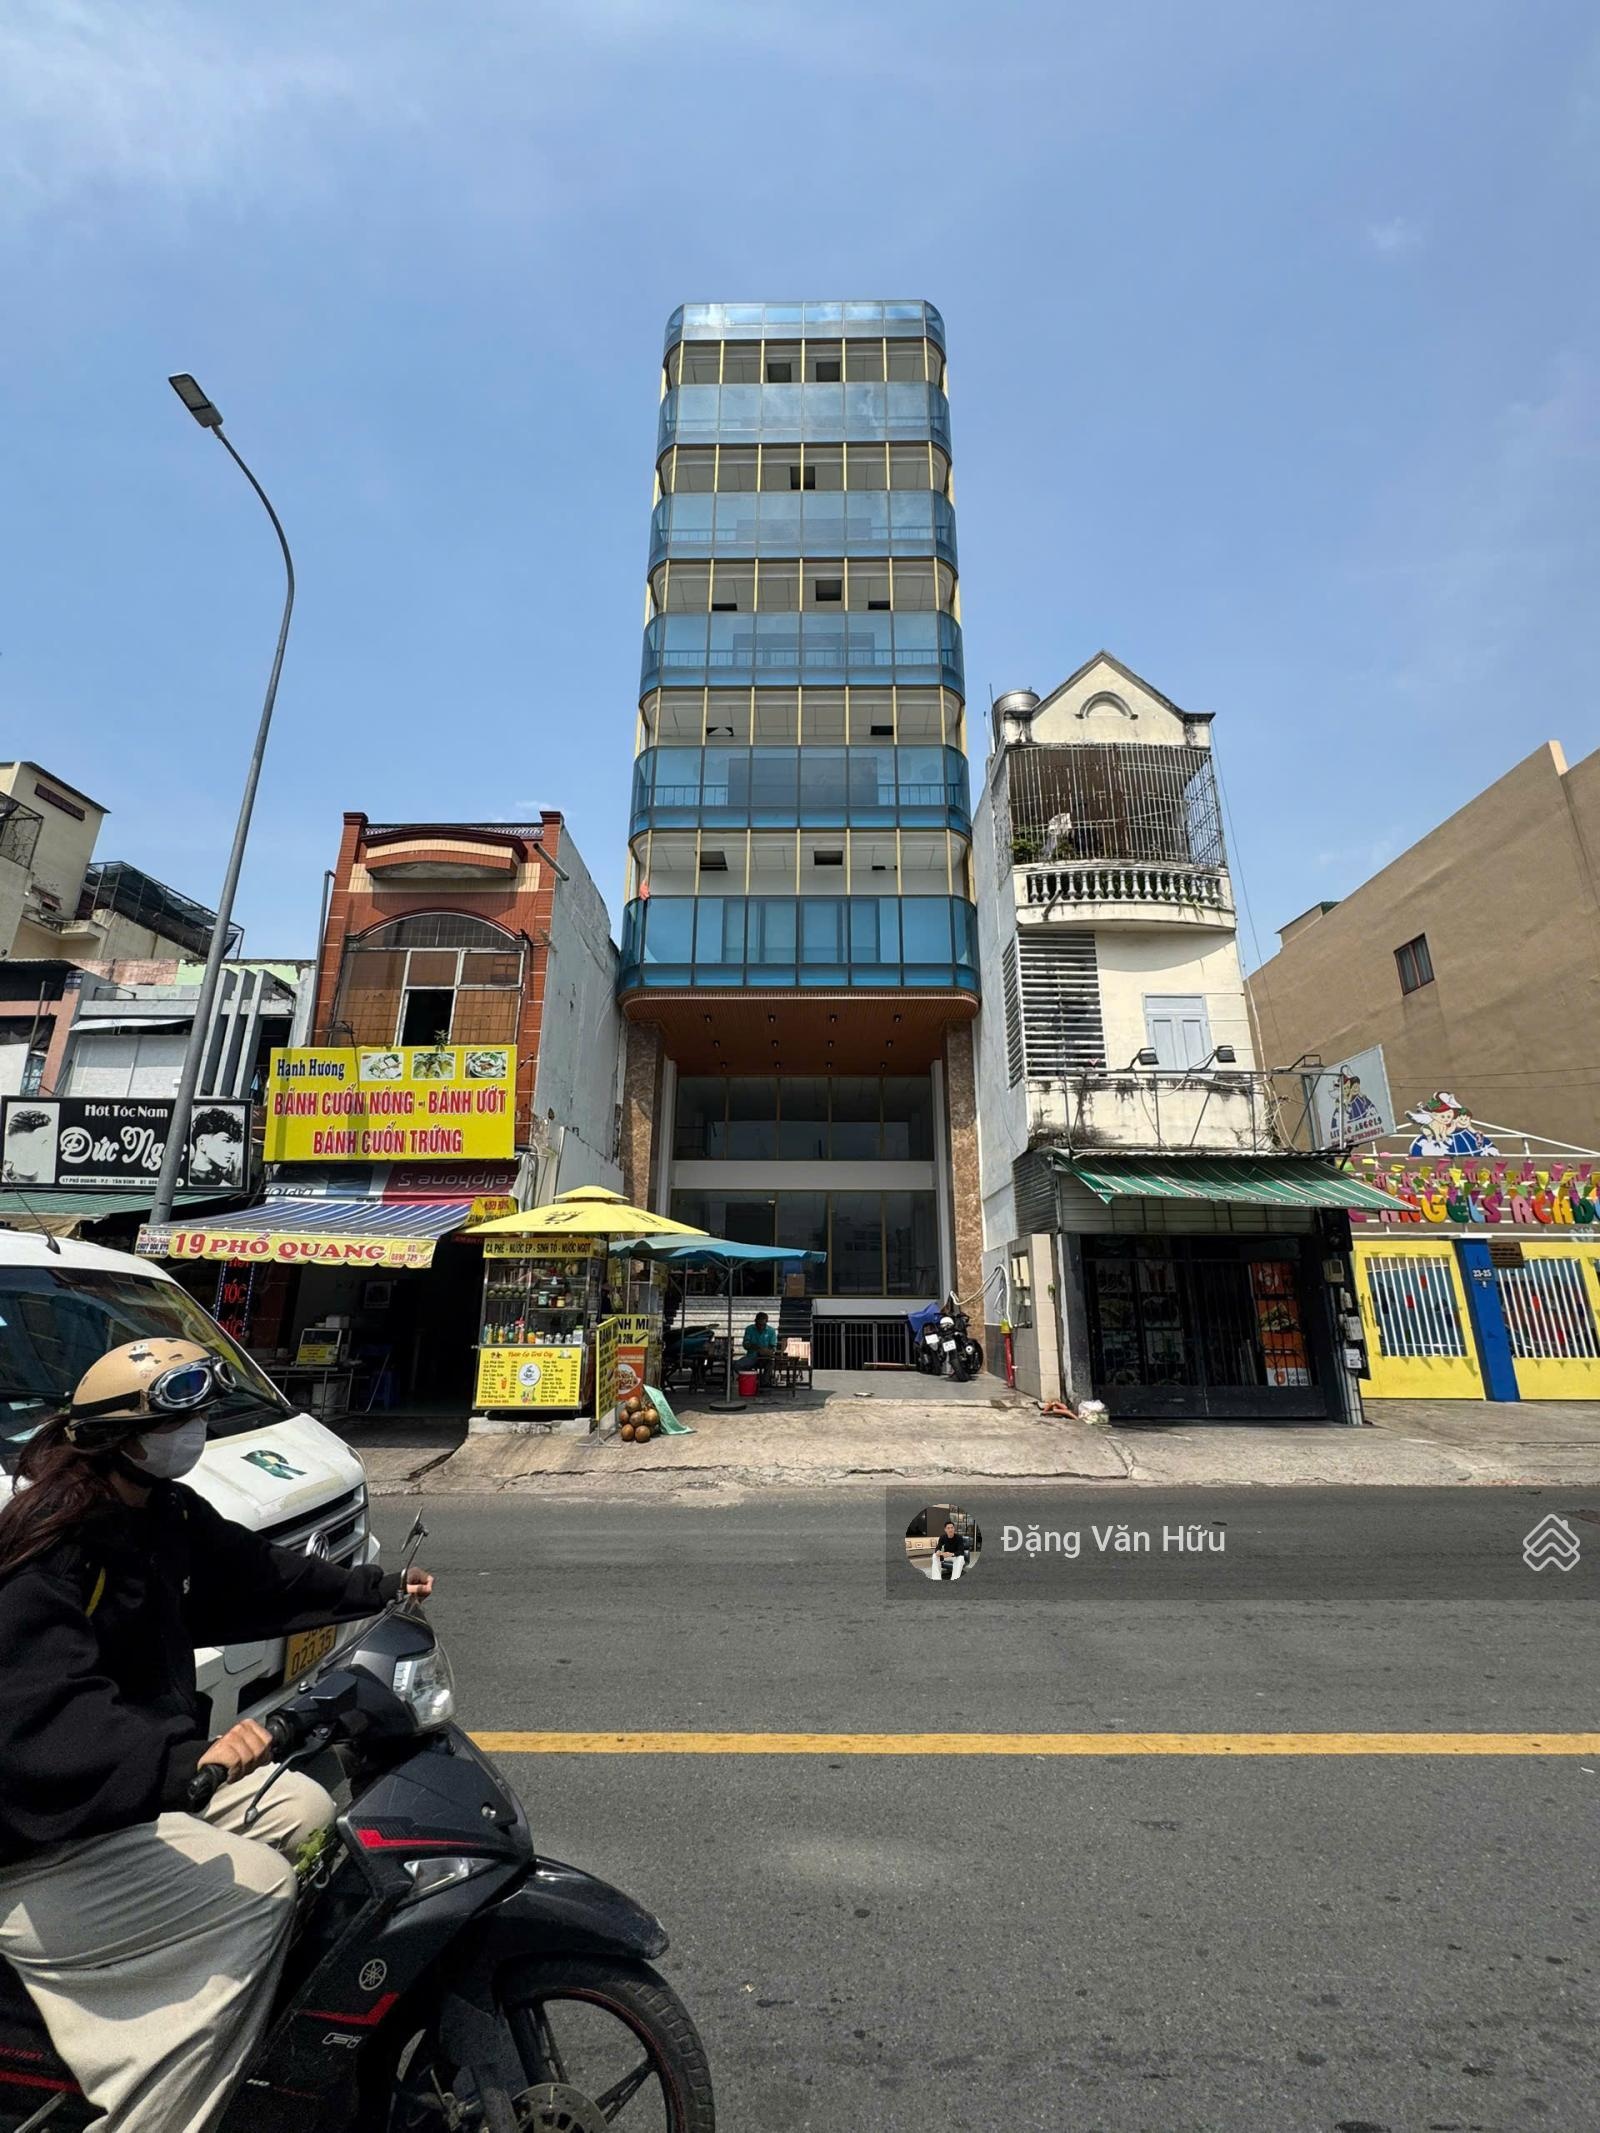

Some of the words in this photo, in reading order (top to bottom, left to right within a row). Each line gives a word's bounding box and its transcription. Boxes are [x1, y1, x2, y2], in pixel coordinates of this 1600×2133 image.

[276, 1059, 306, 1081] Hạnh
[308, 1059, 345, 1081] Hương
[112, 1105, 136, 1118] Tóc
[137, 1105, 169, 1118] Nam
[274, 1087, 318, 1116] BÁNH
[321, 1083, 366, 1116] CUỐN
[369, 1086, 415, 1115] NÓNG
[428, 1085, 473, 1114] BÁNH
[476, 1084, 507, 1113] ƯỚT
[60, 1126, 119, 1164] Đức
[313, 1125, 358, 1154] BÁNH
[361, 1121, 406, 1154] CUỐN
[409, 1124, 464, 1154] TRỨNG
[1510, 1194, 1600, 1224] ACAD
[175, 1233, 207, 1254] 19
[208, 1232, 271, 1254] PHỐ
[277, 1242, 385, 1259] QUANG
